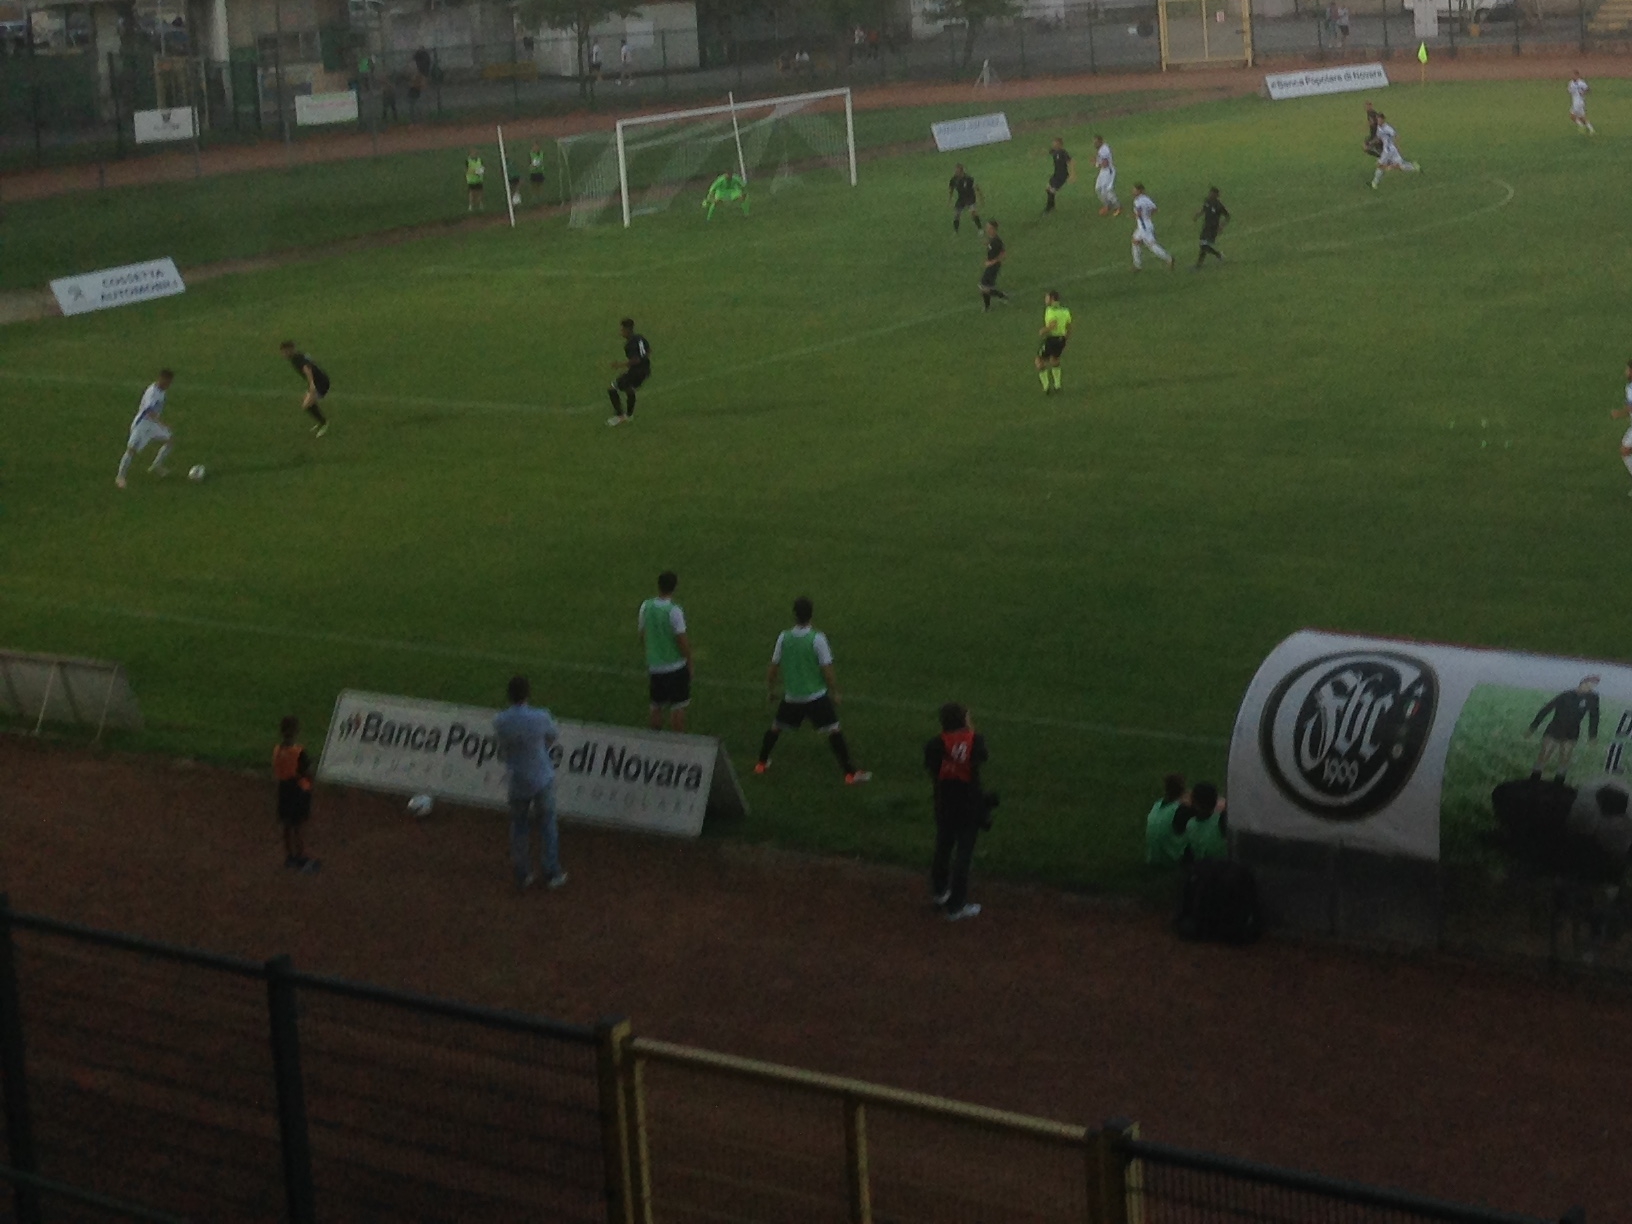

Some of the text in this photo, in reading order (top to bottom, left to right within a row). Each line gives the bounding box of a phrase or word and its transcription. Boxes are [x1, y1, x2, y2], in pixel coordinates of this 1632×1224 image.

[360, 710, 704, 793] Banca Pope di Novara
[1604, 741, 1625, 776] IL
